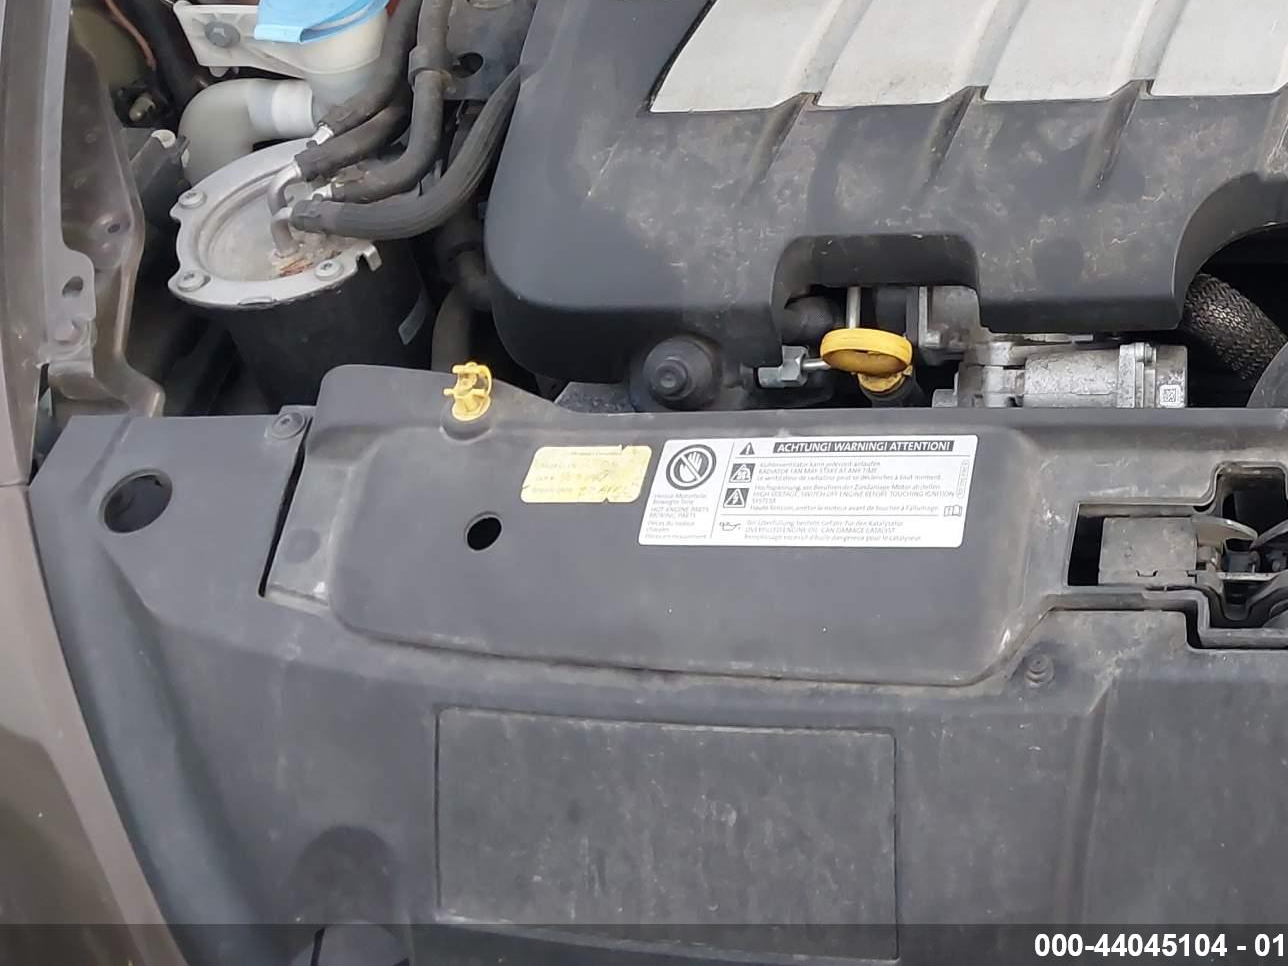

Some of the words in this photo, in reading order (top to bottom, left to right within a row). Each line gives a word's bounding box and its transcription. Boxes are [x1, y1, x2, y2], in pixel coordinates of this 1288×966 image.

[776, 442, 832, 452] ACHTUNG!
[833, 442, 888, 452] WARNING!
[888, 441, 951, 451] ATTENTION!
